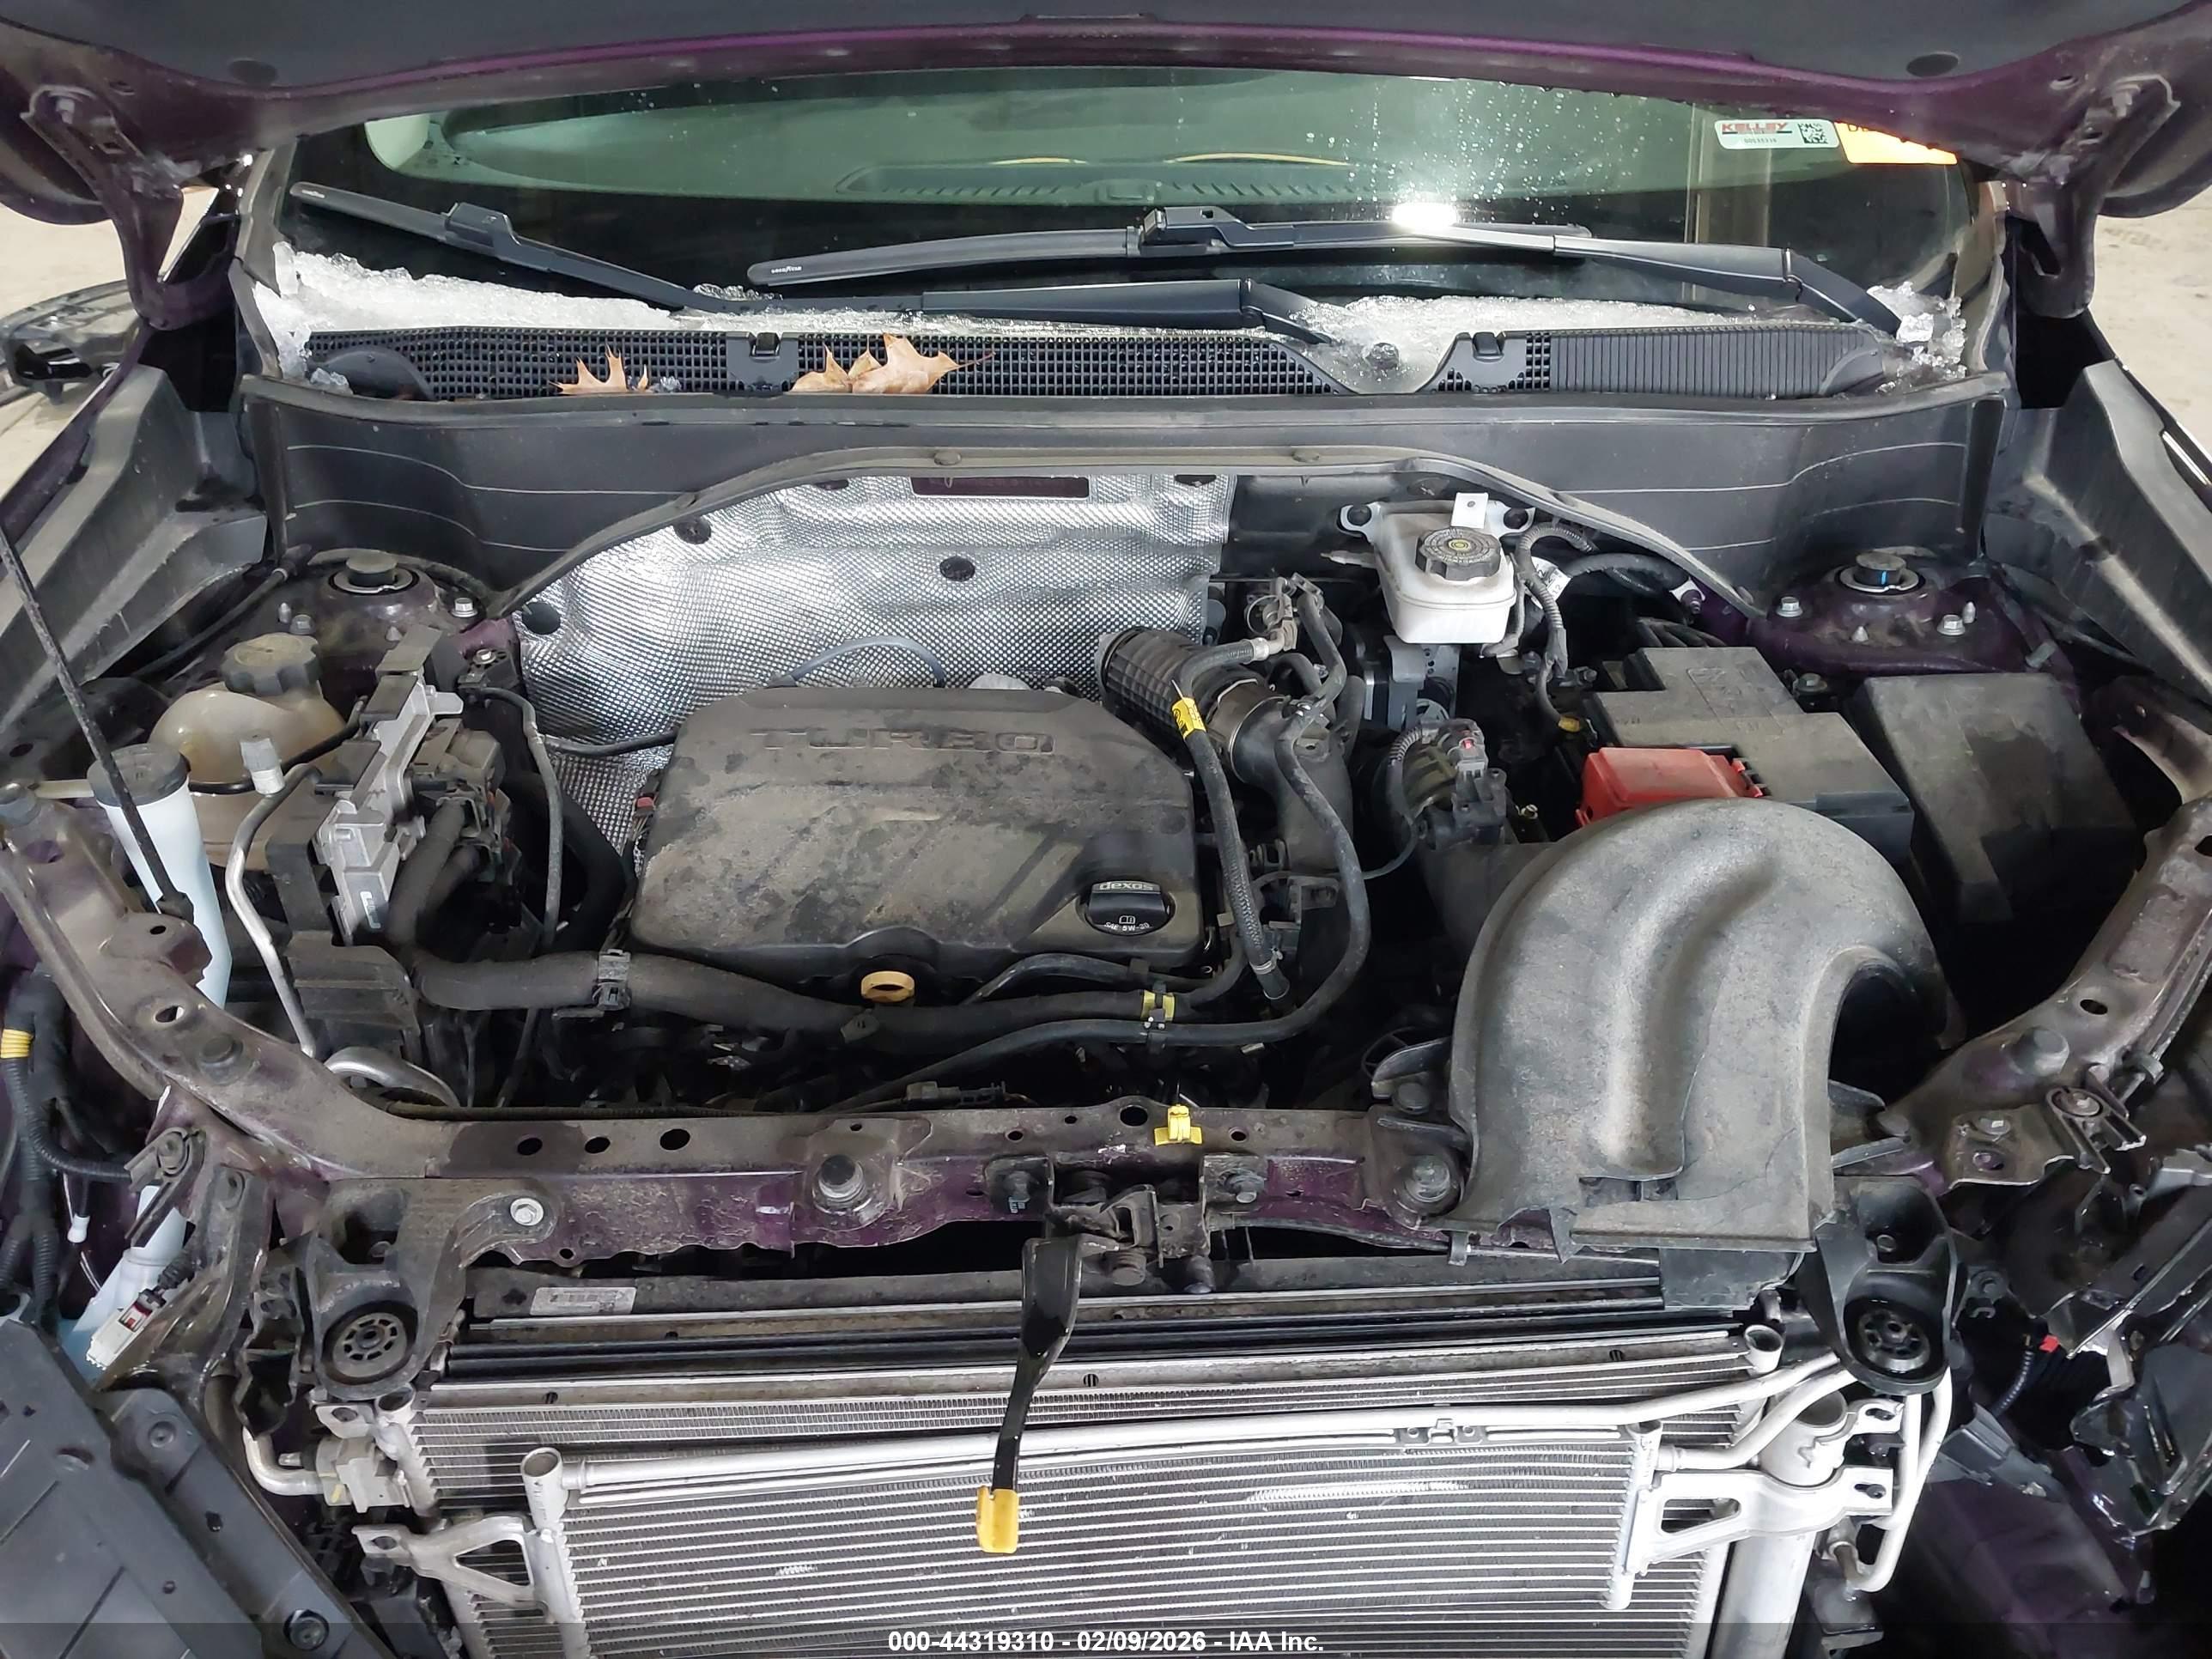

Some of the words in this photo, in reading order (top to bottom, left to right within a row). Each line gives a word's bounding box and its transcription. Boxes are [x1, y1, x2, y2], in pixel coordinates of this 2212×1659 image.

[1722, 123, 1788, 131] KELLEY
[750, 727, 1055, 755] TURBO
[1099, 881, 1154, 890] dexos
[1104, 921, 1119, 930] SAE
